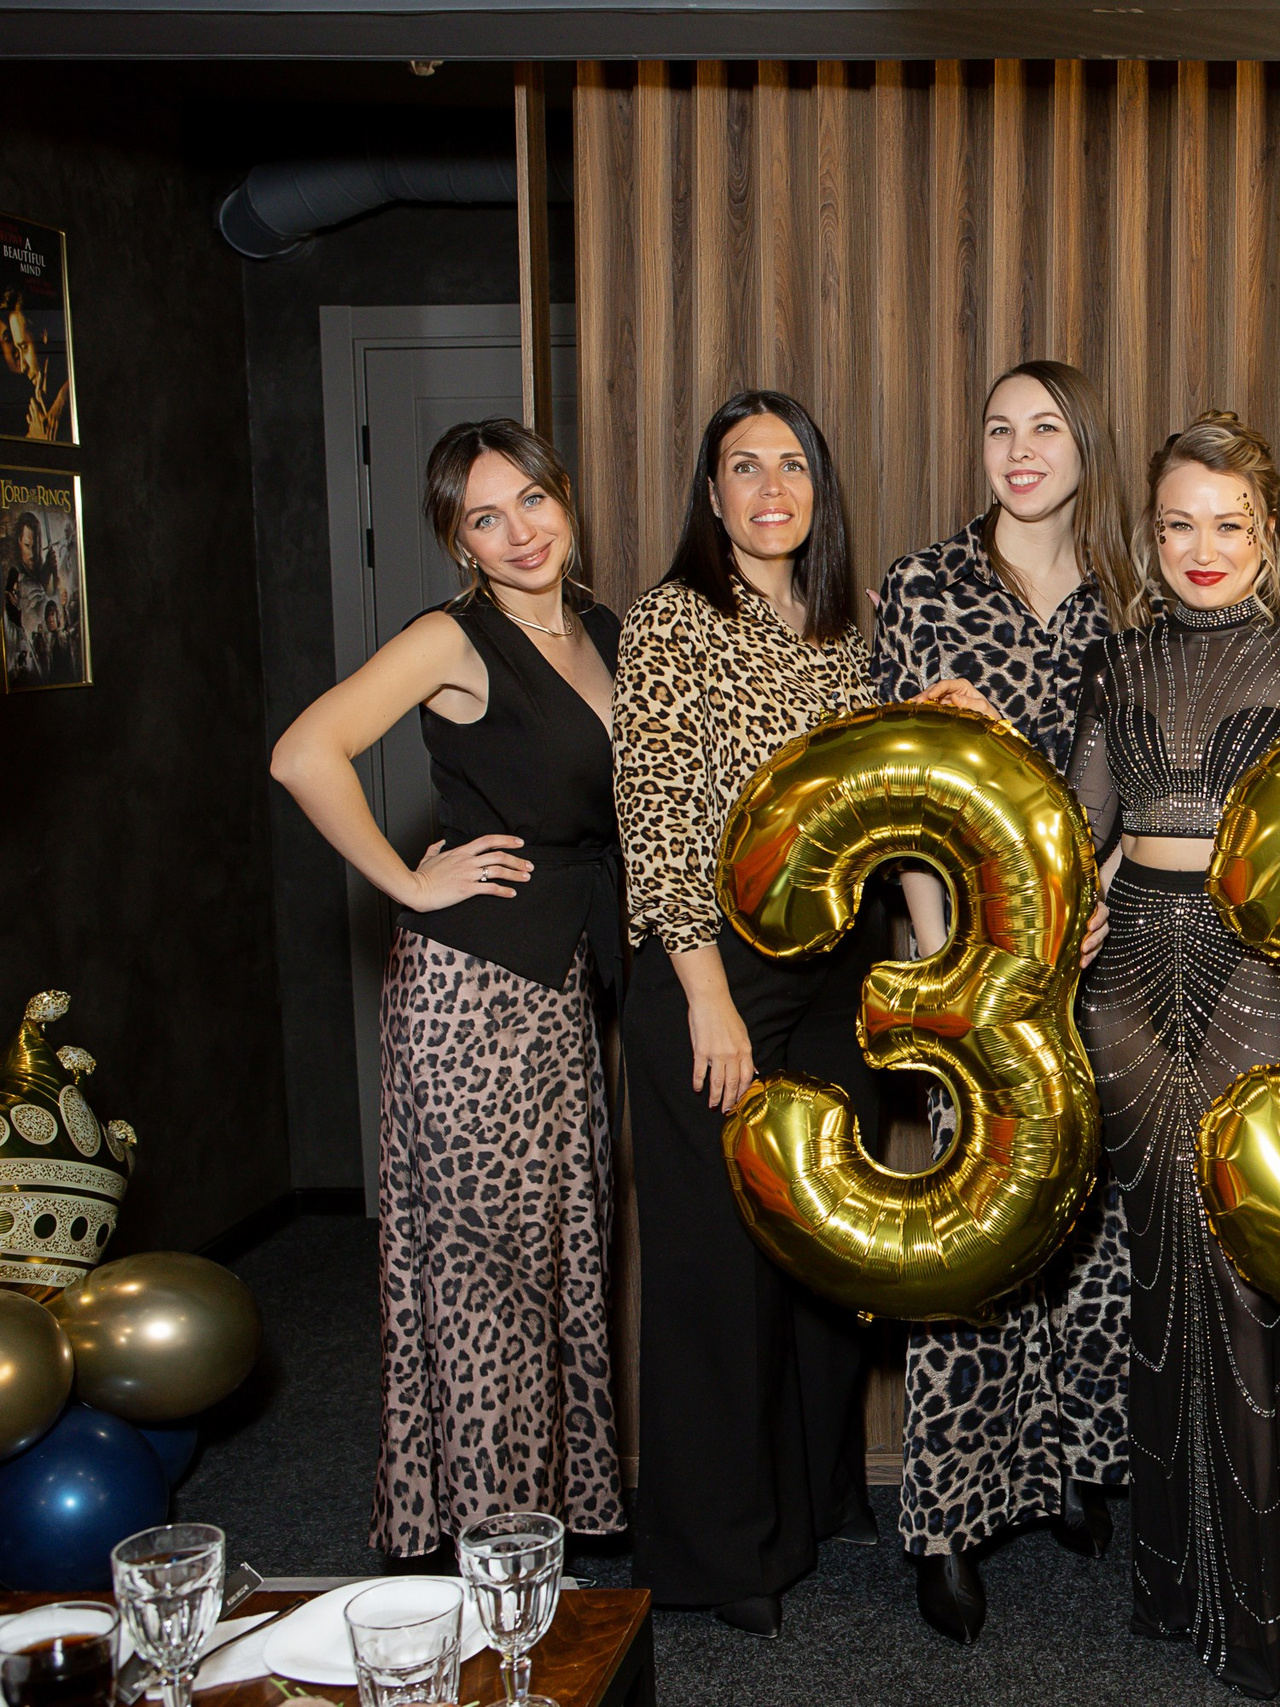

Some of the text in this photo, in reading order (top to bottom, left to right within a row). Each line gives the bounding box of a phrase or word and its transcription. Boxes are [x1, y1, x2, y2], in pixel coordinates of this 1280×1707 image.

[25, 238, 32, 250] A
[3, 244, 46, 267] BEAUTIFUL
[20, 263, 41, 277] MIND
[1, 479, 30, 509] LORD
[37, 485, 71, 513] RINGS
